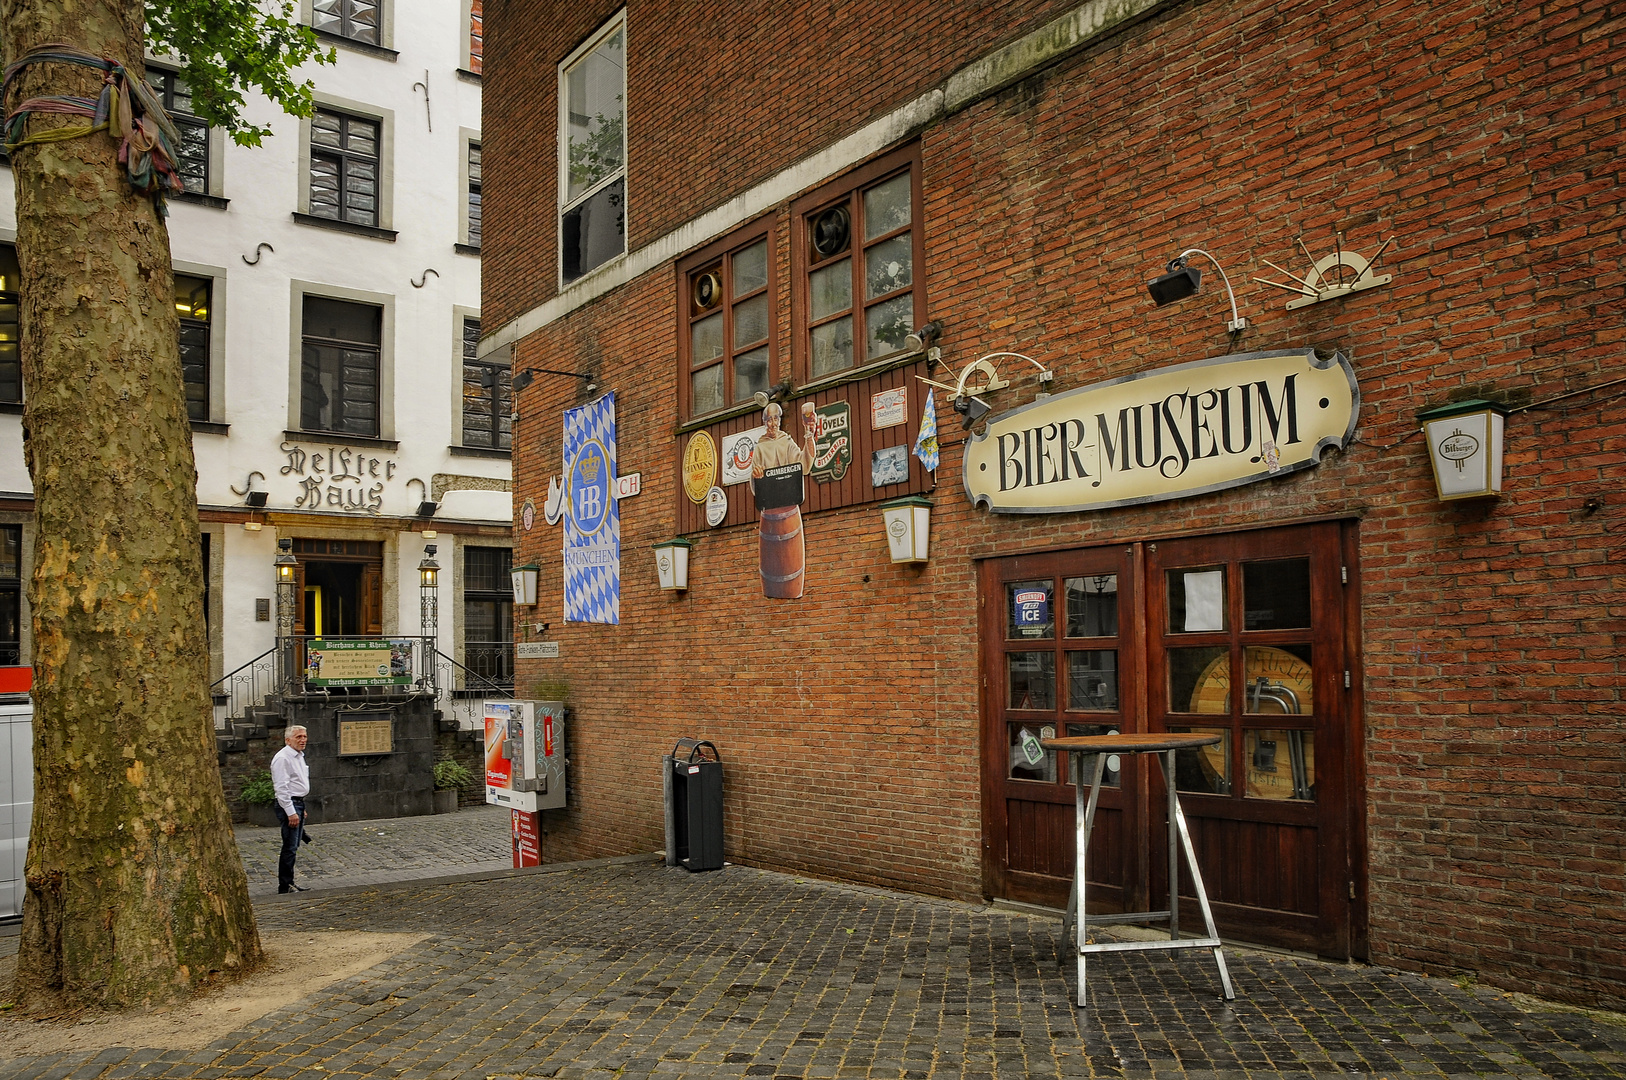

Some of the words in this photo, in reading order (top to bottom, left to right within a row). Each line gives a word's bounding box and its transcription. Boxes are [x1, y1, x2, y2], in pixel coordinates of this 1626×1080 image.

[877, 408, 901, 418] Budweiser
[996, 372, 1302, 492] BIER-MUSEUM
[817, 438, 846, 467] BITTERBIER
[1444, 443, 1473, 453] Bitburger
[280, 442, 396, 483] Delfter
[766, 464, 801, 477] GRIMBERGEN
[294, 475, 384, 515] Haus
[579, 485, 601, 521] HB
[566, 549, 615, 565] MÜNCHEN
[1019, 593, 1042, 602] SMIRNOFF
[1022, 610, 1040, 621] ICE
[325, 641, 354, 649] Bierhaus
[368, 641, 387, 649] Rhein
